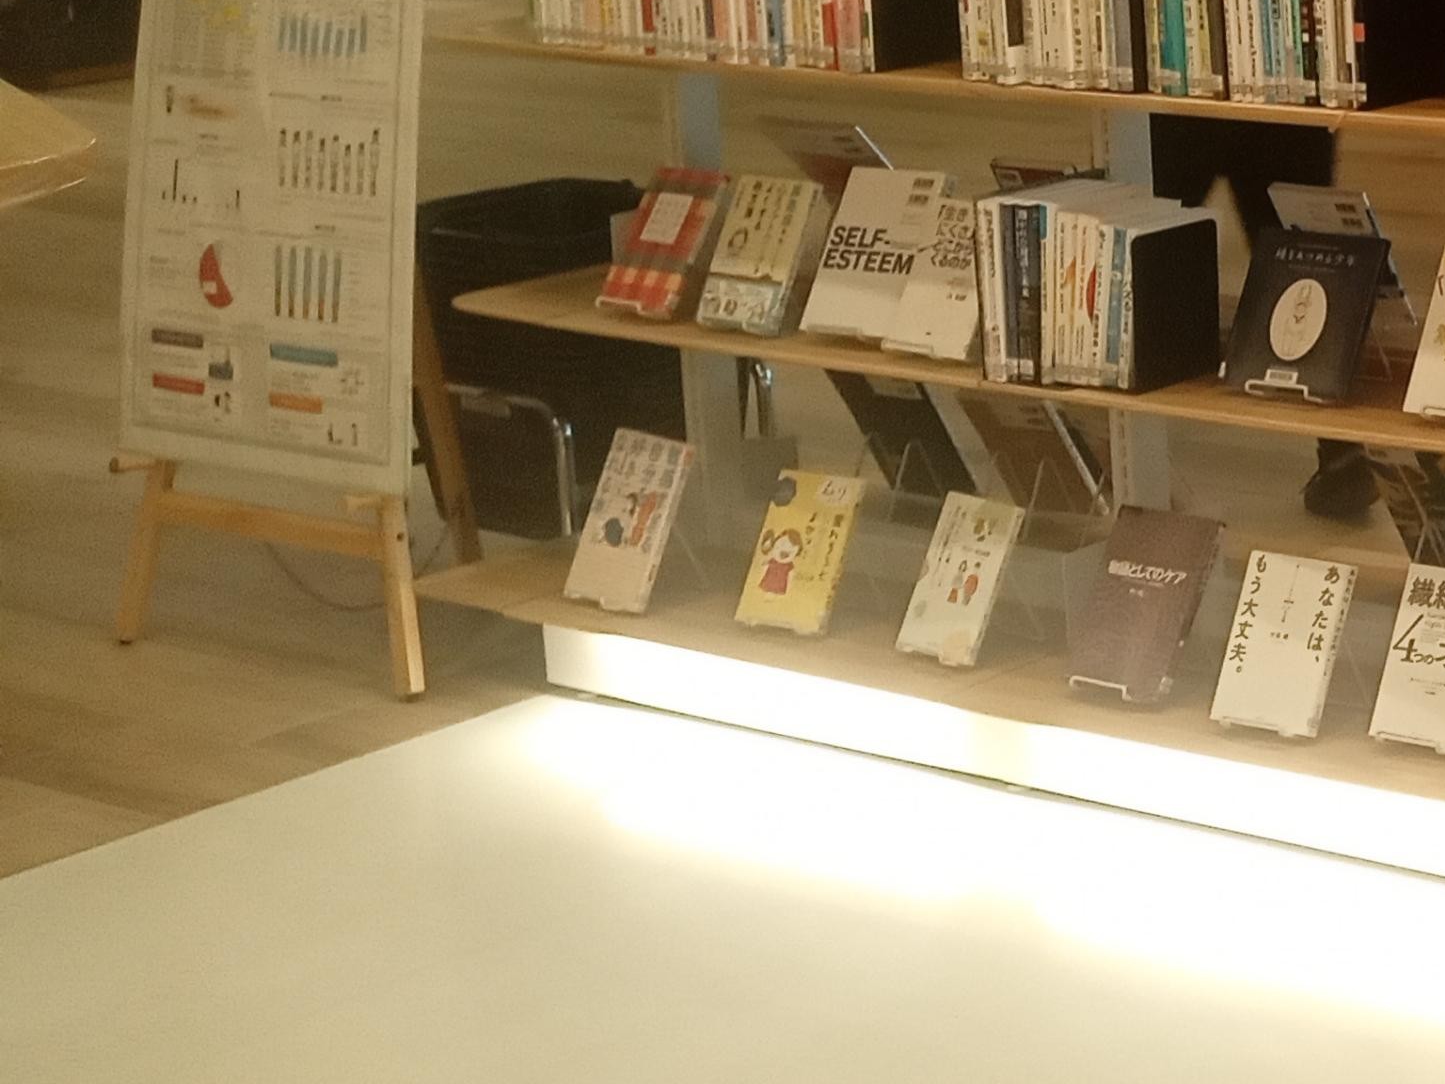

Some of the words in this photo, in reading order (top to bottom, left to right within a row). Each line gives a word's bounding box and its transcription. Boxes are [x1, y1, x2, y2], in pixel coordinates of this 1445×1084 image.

[822, 248, 915, 276] ESTEEM
[829, 225, 892, 250] SELF-
[1228, 554, 1269, 674] もう大丈夫。
[1306, 565, 1343, 665] あなたは、
